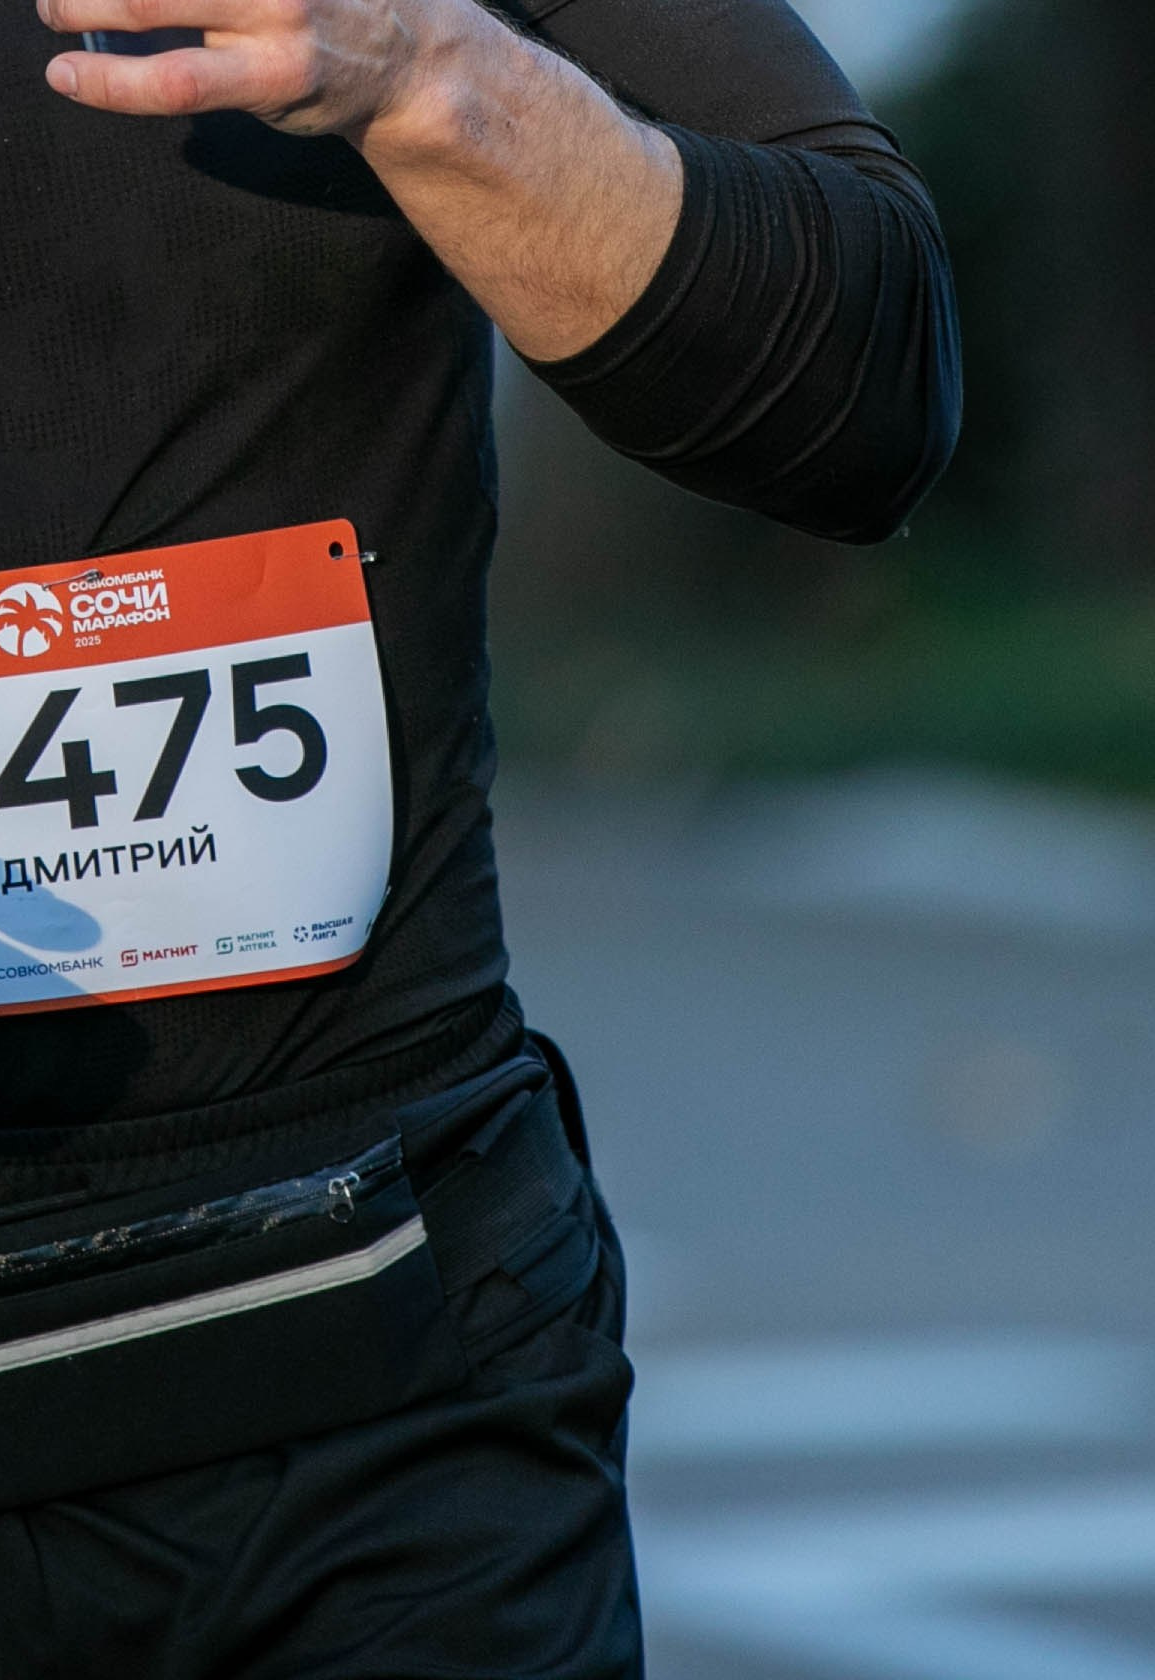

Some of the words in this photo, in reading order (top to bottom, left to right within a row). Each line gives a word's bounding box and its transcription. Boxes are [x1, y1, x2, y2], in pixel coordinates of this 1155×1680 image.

[68, 569, 164, 593] СОВКОМБАНК
[70, 582, 169, 619] СОЧИ
[73, 606, 170, 634] МАРАФОН
[74, 635, 102, 648] 2025
[0, 825, 218, 895] ДМИТРИЙ
[237, 930, 275, 943] МАГНИТ
[311, 929, 337, 942] ЛИГА
[143, 944, 198, 962] МАГНИТ
[238, 940, 277, 953] АПТЕКА
